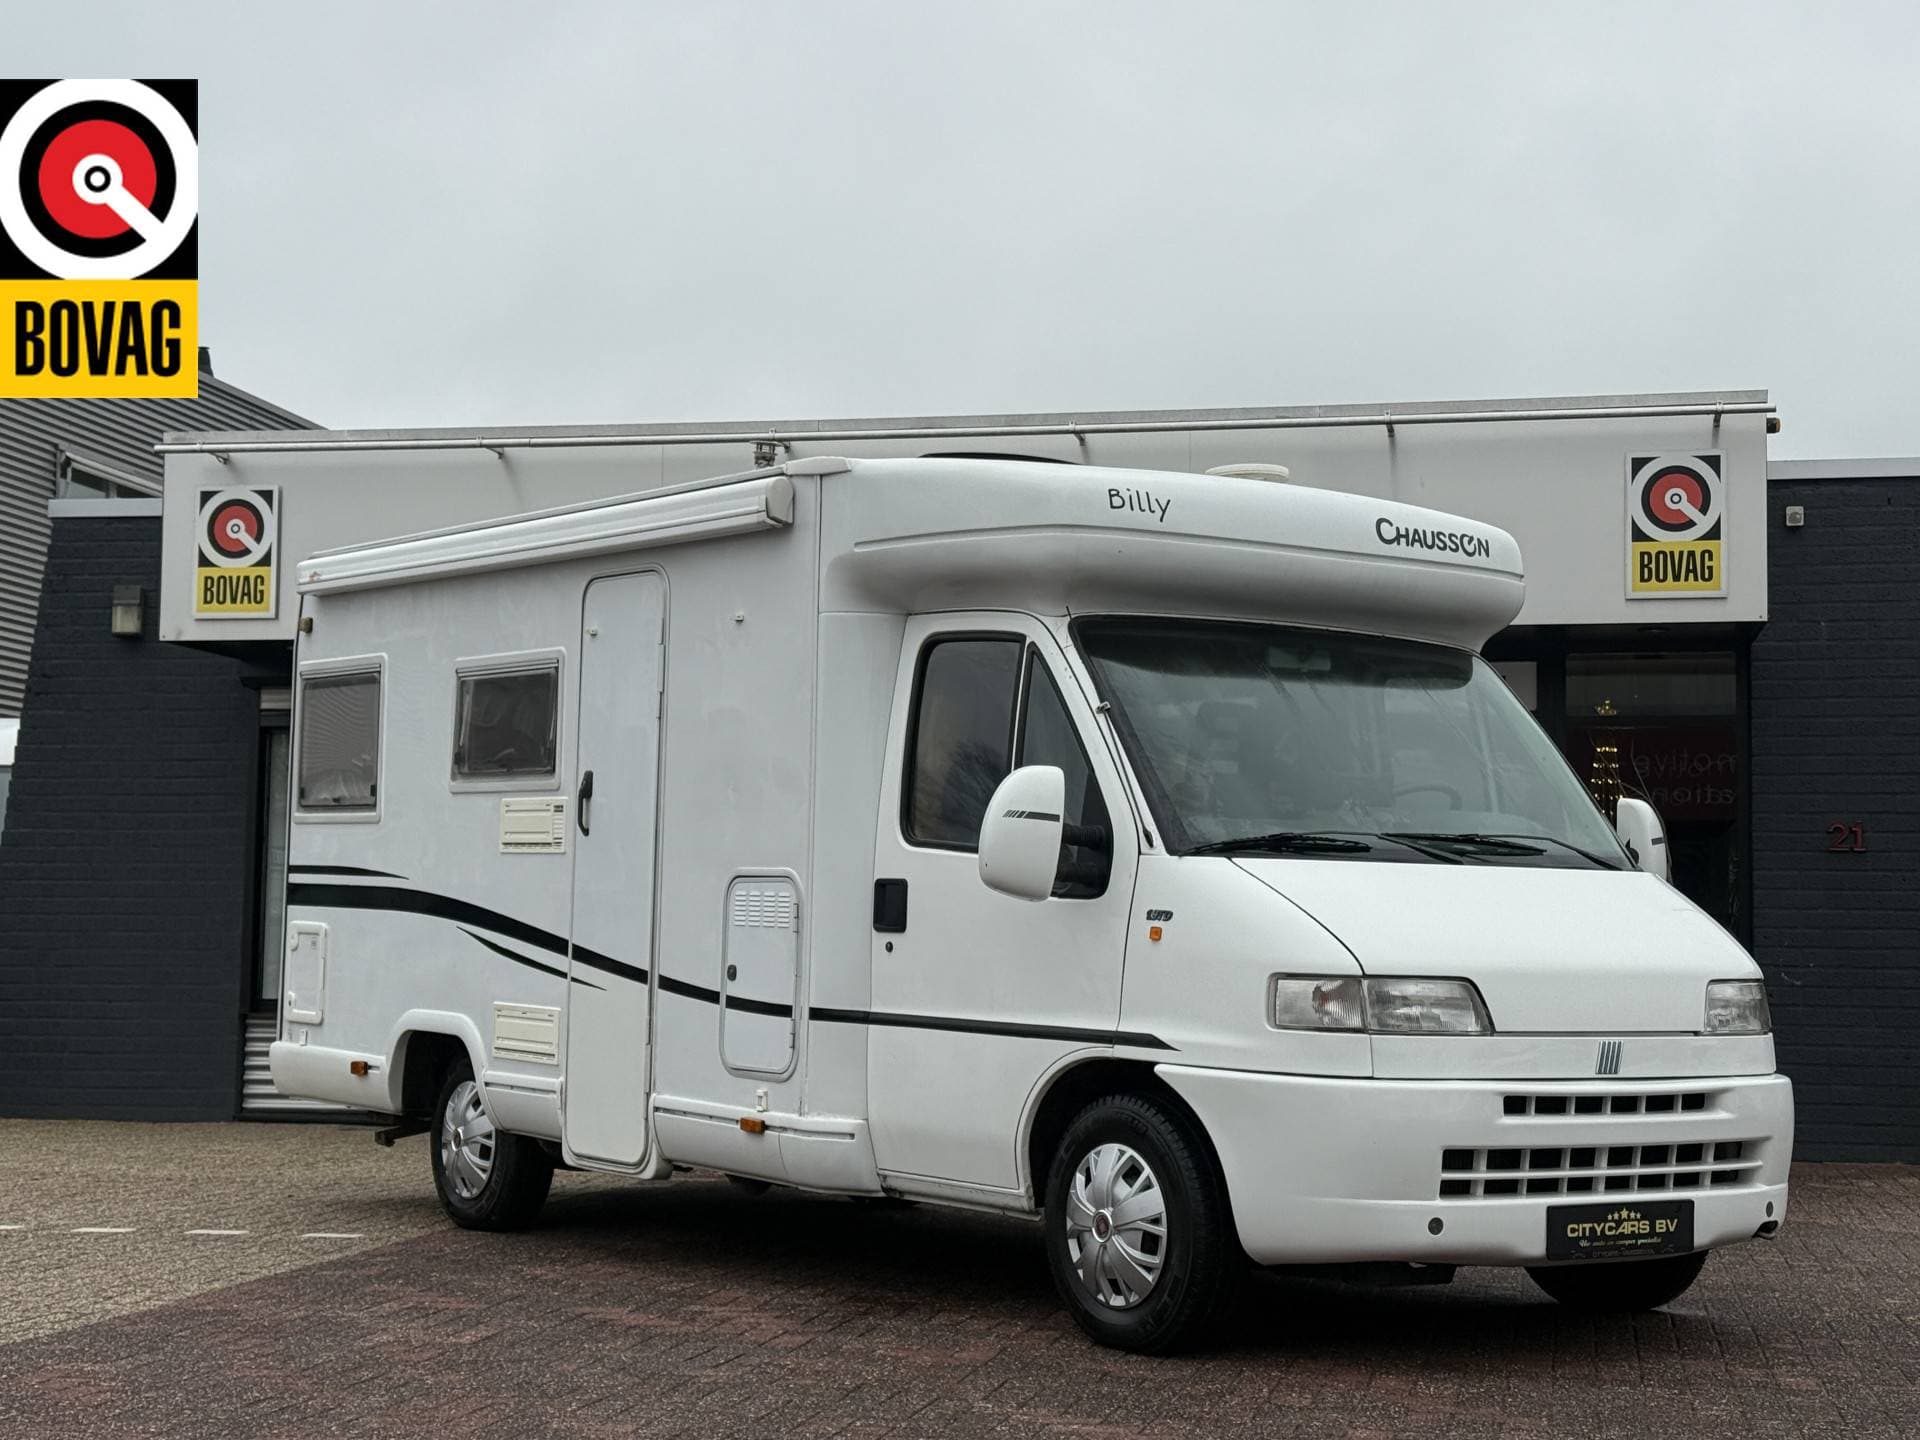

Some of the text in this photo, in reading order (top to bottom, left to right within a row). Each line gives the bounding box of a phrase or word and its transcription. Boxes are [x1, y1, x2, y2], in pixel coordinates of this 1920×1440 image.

[1107, 488, 1171, 522] Billy
[1375, 517, 1491, 558] CHAUSSON
[1639, 549, 1714, 583] BOVAG
[203, 575, 265, 605] BOVAG
[1826, 820, 1867, 850] 21
[1567, 1218, 1678, 1237] CITYCARS BV
